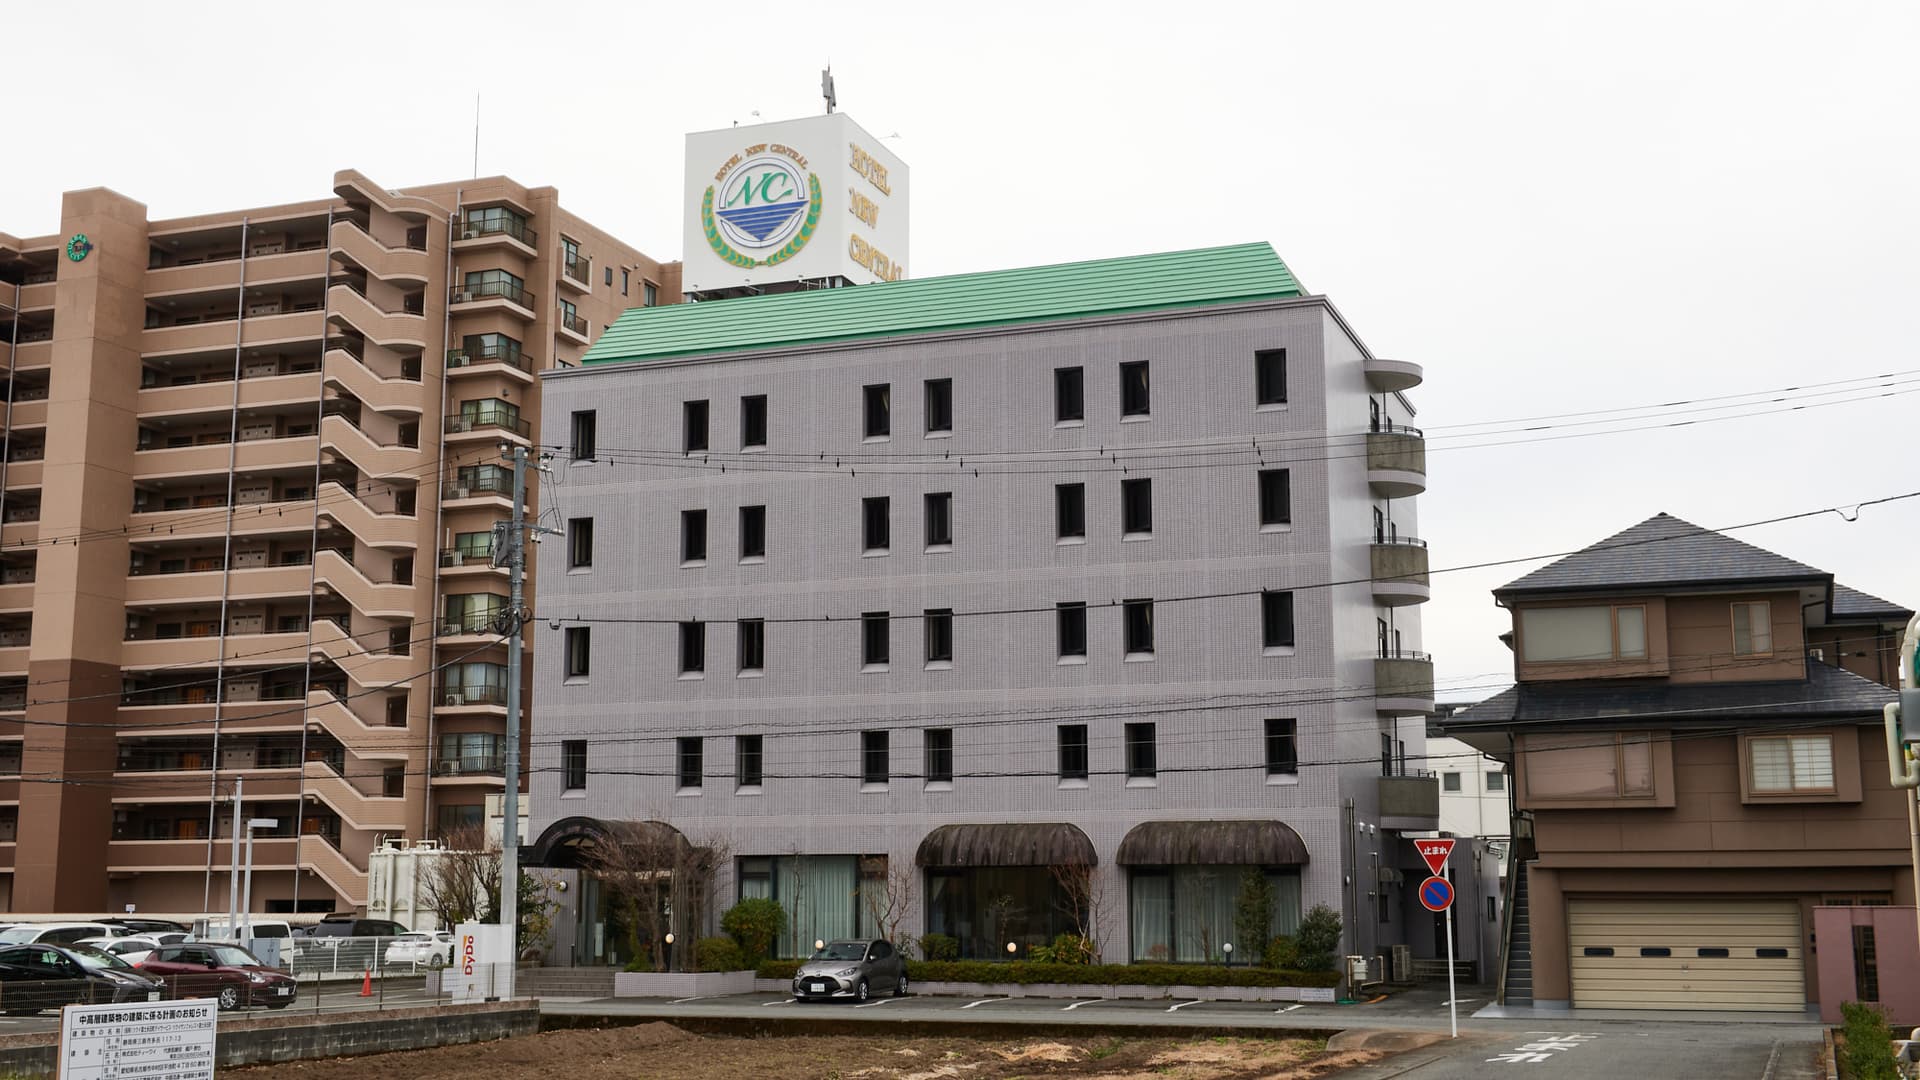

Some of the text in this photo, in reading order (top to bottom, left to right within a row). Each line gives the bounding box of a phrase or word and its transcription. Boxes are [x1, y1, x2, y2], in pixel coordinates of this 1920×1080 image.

[714, 143, 808, 182] HOTEL NEW CENTRAL
[849, 142, 891, 197] HOTEL
[727, 172, 793, 206] NC
[849, 187, 879, 230] NEW
[1423, 846, 1448, 855] 止まれ
